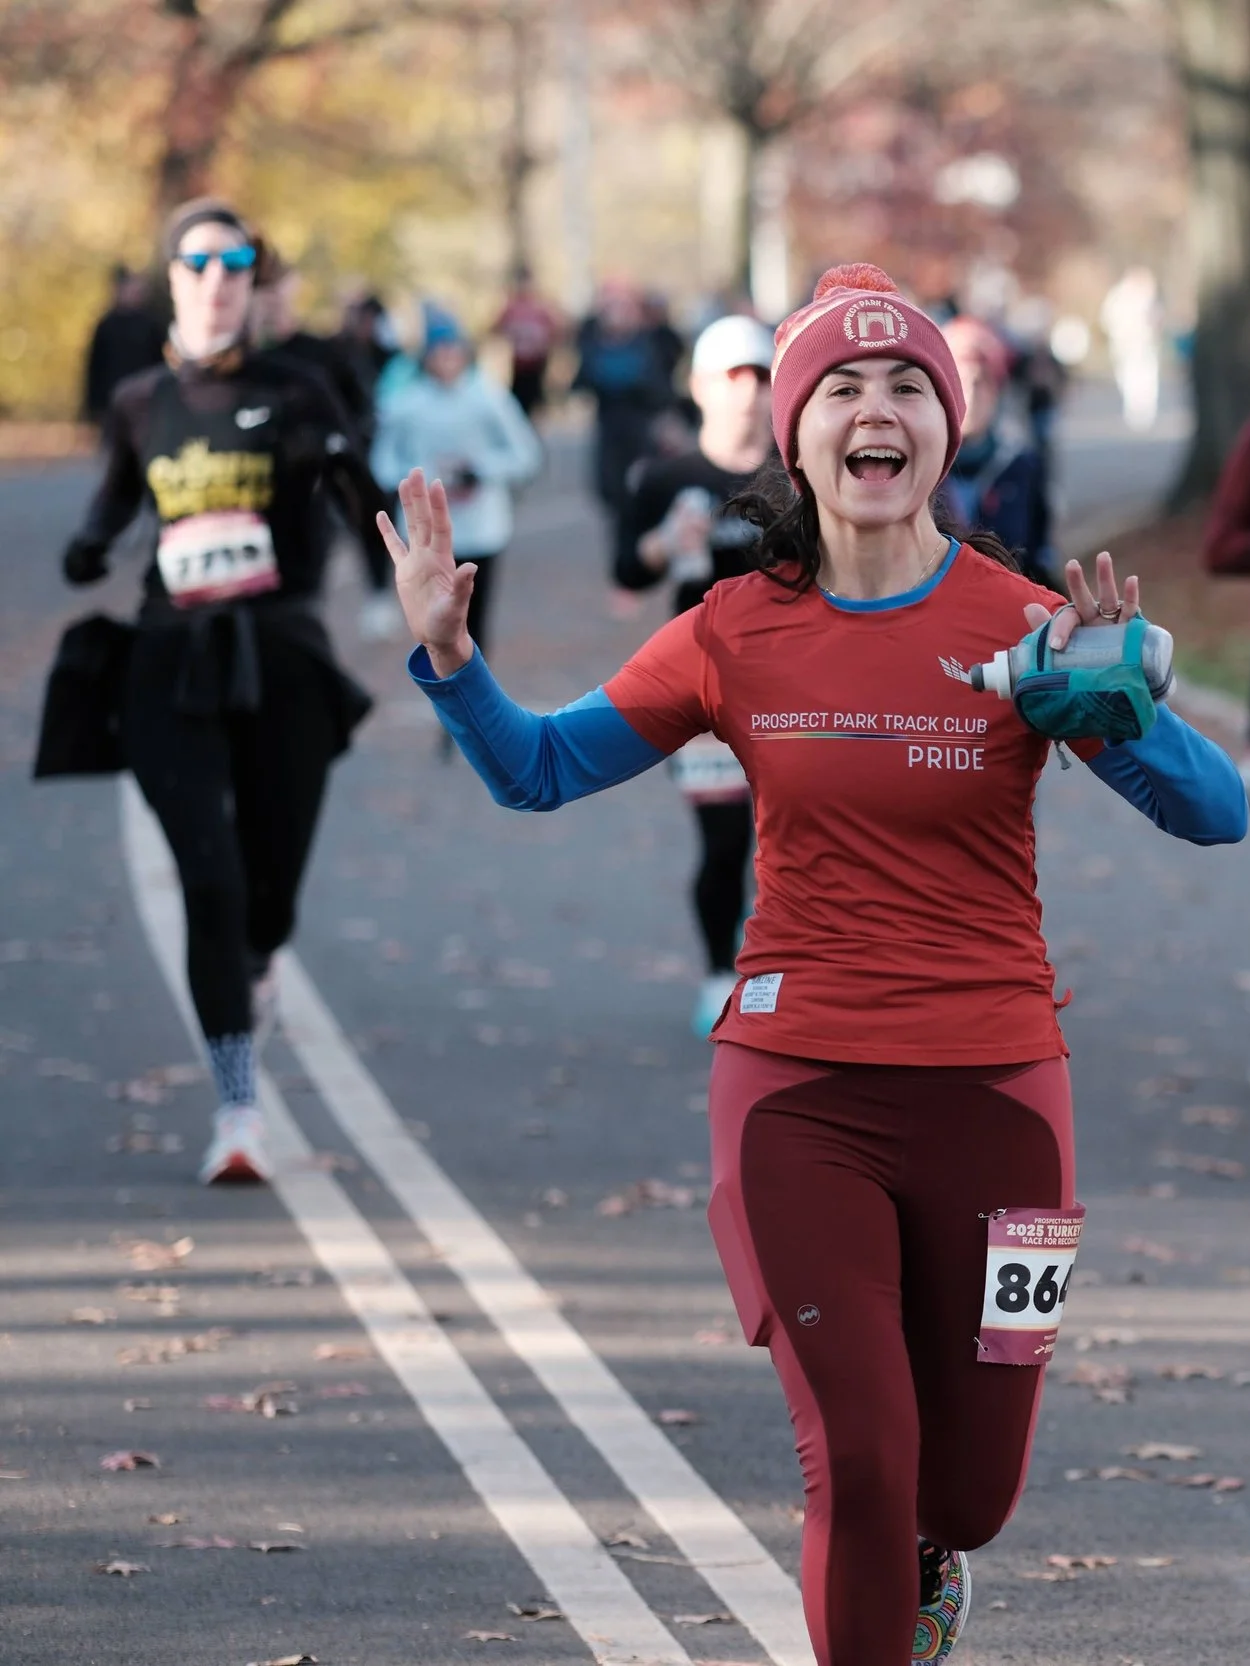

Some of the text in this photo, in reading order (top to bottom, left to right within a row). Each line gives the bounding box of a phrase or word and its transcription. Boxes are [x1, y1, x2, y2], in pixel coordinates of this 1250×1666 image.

[843, 303, 860, 340] PROSPECT
[859, 299, 882, 307] PARK
[883, 302, 906, 323] TRACK
[858, 337, 898, 348] BROOKLYN
[751, 712, 988, 734] PROSPECT PARK TRACK CLUB
[908, 745, 985, 771] PRIDE
[1034, 1217, 1061, 1225] PROSPECT
[1006, 1223, 1044, 1237] 2025
[1022, 1237, 1042, 1245] RACE
[1044, 1237, 1057, 1245] FOR
